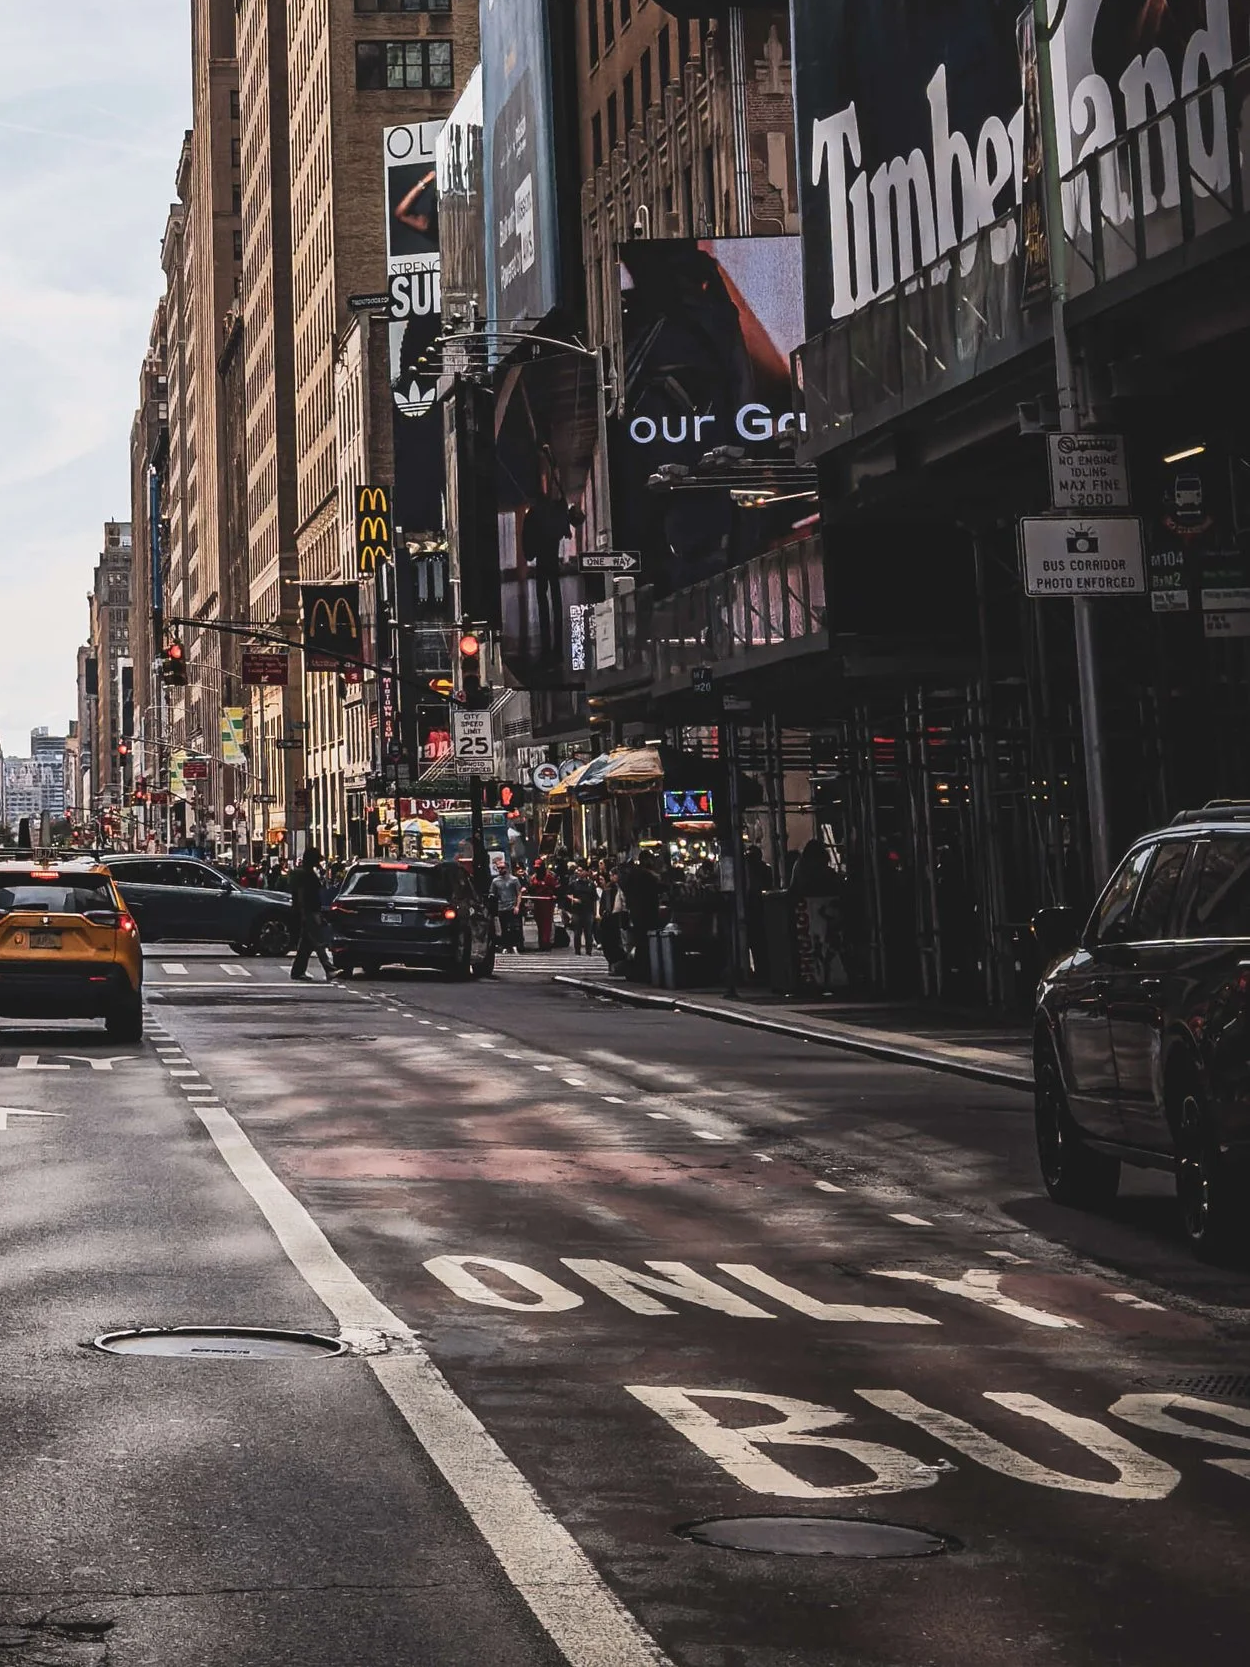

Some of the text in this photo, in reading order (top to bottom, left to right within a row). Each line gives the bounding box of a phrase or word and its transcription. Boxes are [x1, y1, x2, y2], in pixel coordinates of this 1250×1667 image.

[1058, 455, 1119, 466] NO ENGINE
[1070, 468, 1108, 477] IDLING
[1059, 479, 1121, 491] MAX FINE
[1069, 494, 1114, 505] $2000
[586, 556, 631, 566] ONE WAY
[1043, 559, 1126, 571] BUS CORRIDOR
[1036, 577, 1135, 589] PHOTO ENFORCED
[463, 713, 480, 721] CITY
[459, 736, 489, 755] 25
[421, 1254, 1085, 1329] ONLY
